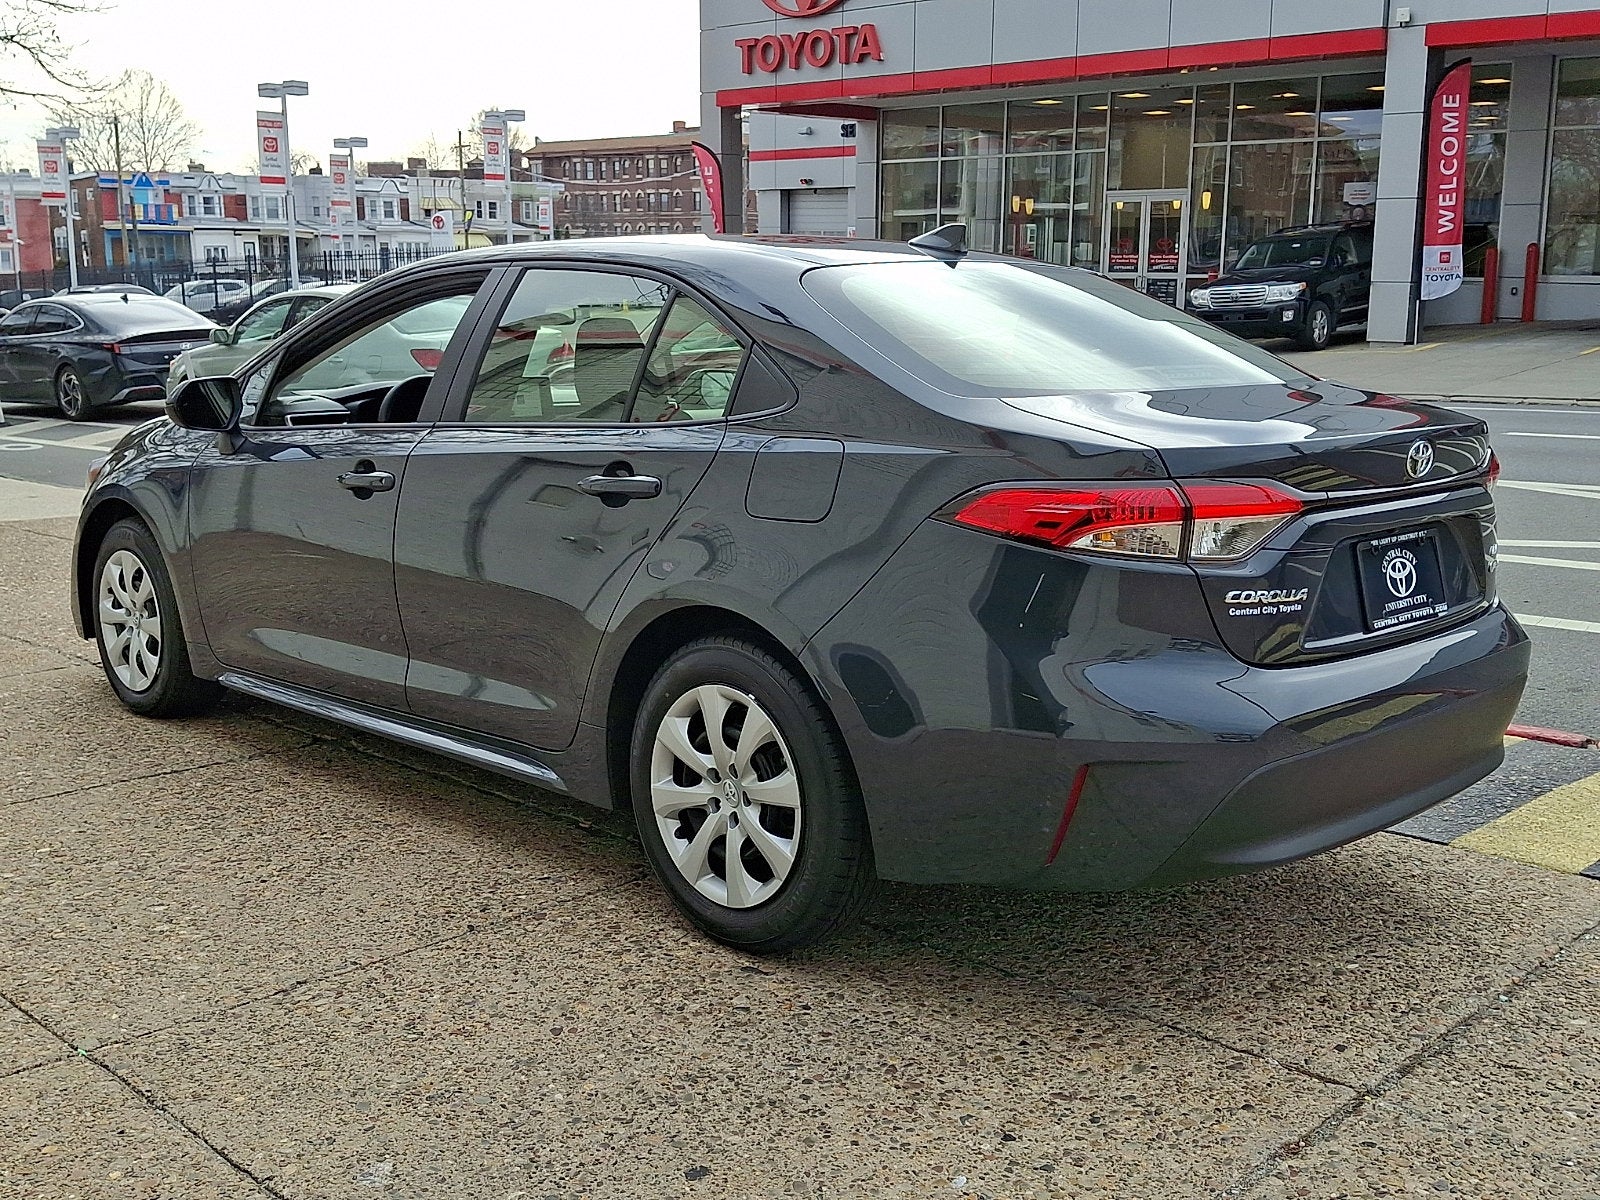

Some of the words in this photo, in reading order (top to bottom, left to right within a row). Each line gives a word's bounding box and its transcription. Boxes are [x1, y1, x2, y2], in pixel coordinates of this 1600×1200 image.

[735, 23, 884, 74] TOYOTA
[1437, 93, 1460, 234] WELCOME
[1425, 273, 1462, 282] TOYOTA
[1381, 548, 1402, 573] CENTRAL
[1402, 549, 1418, 565] CITY
[1224, 587, 1308, 604] COROLLA
[1385, 598, 1414, 611] UNIVERSITY
[1413, 594, 1427, 605] CITY
[1229, 606, 1260, 616] Central
[1262, 605, 1277, 614] City
[1279, 603, 1302, 613] Toyota
[1373, 617, 1399, 629] CENTRAL
[1399, 613, 1412, 622] CITY
[1412, 607, 1434, 618] TOYOTA
